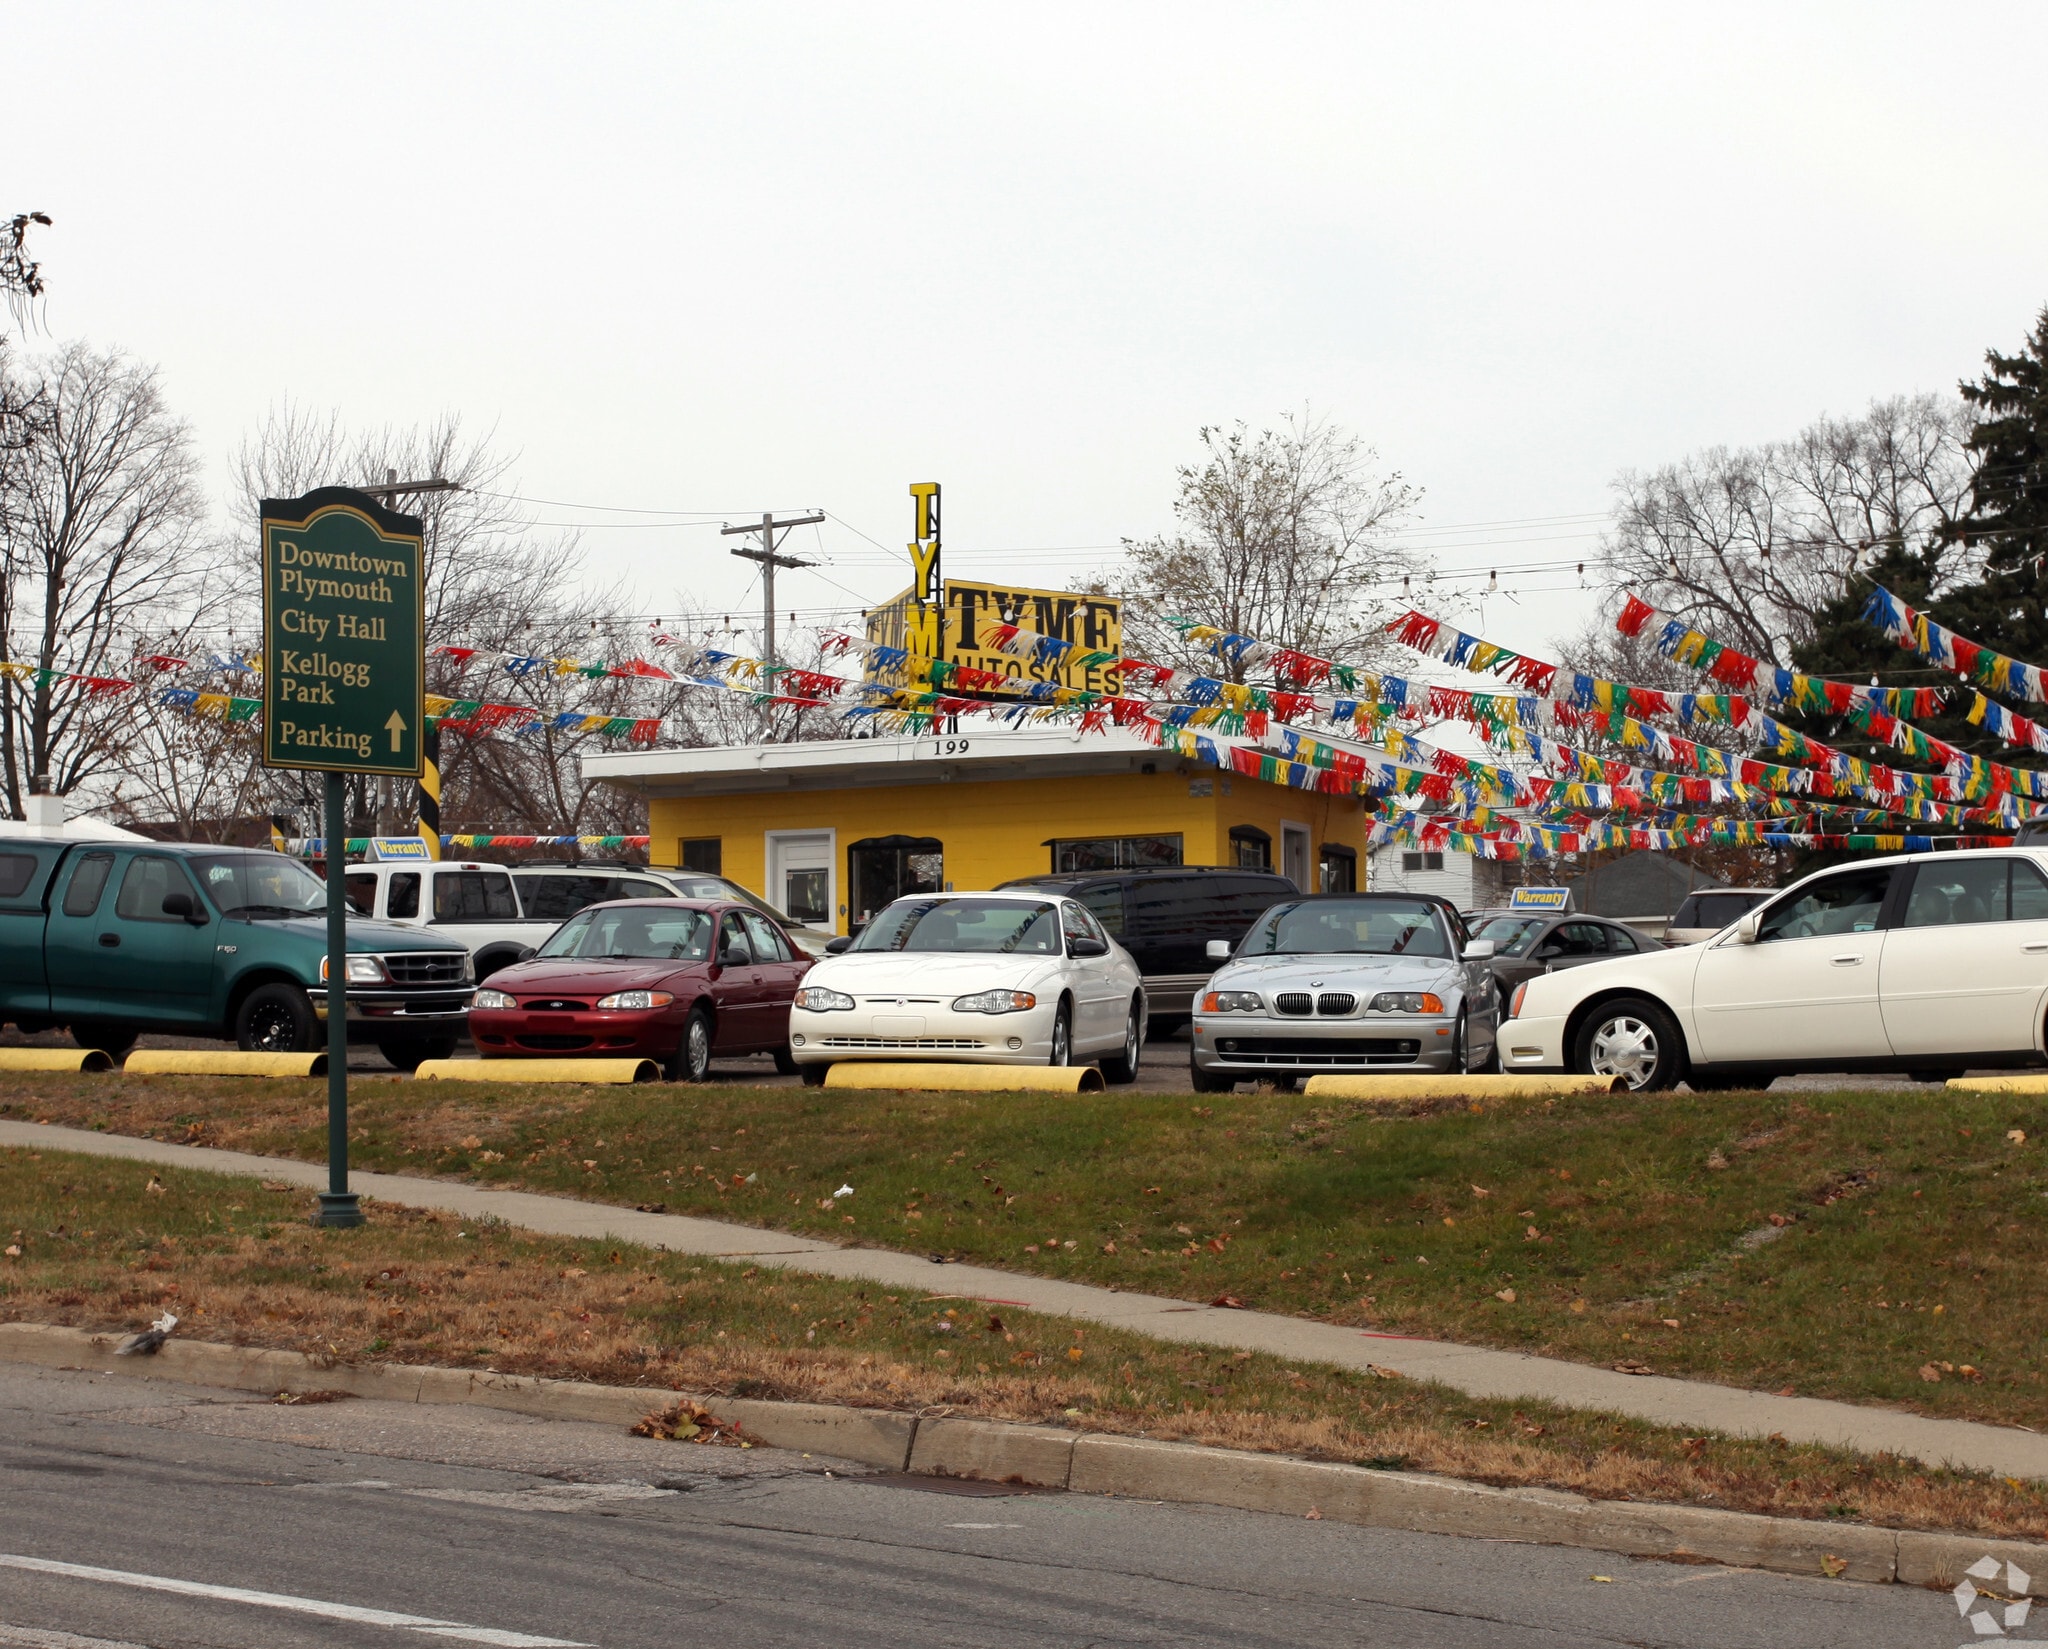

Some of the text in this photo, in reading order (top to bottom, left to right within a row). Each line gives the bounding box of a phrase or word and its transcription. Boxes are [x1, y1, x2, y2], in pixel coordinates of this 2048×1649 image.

[279, 541, 407, 577] Downtown
[280, 569, 393, 603] Plymouth
[281, 609, 386, 642] City Hall
[281, 650, 371, 688] Kellogg
[281, 678, 335, 704] Park
[280, 721, 372, 758] Parking
[934, 739, 969, 755] 199
[377, 841, 424, 856] Warranty
[1517, 891, 1562, 905] Warranty
